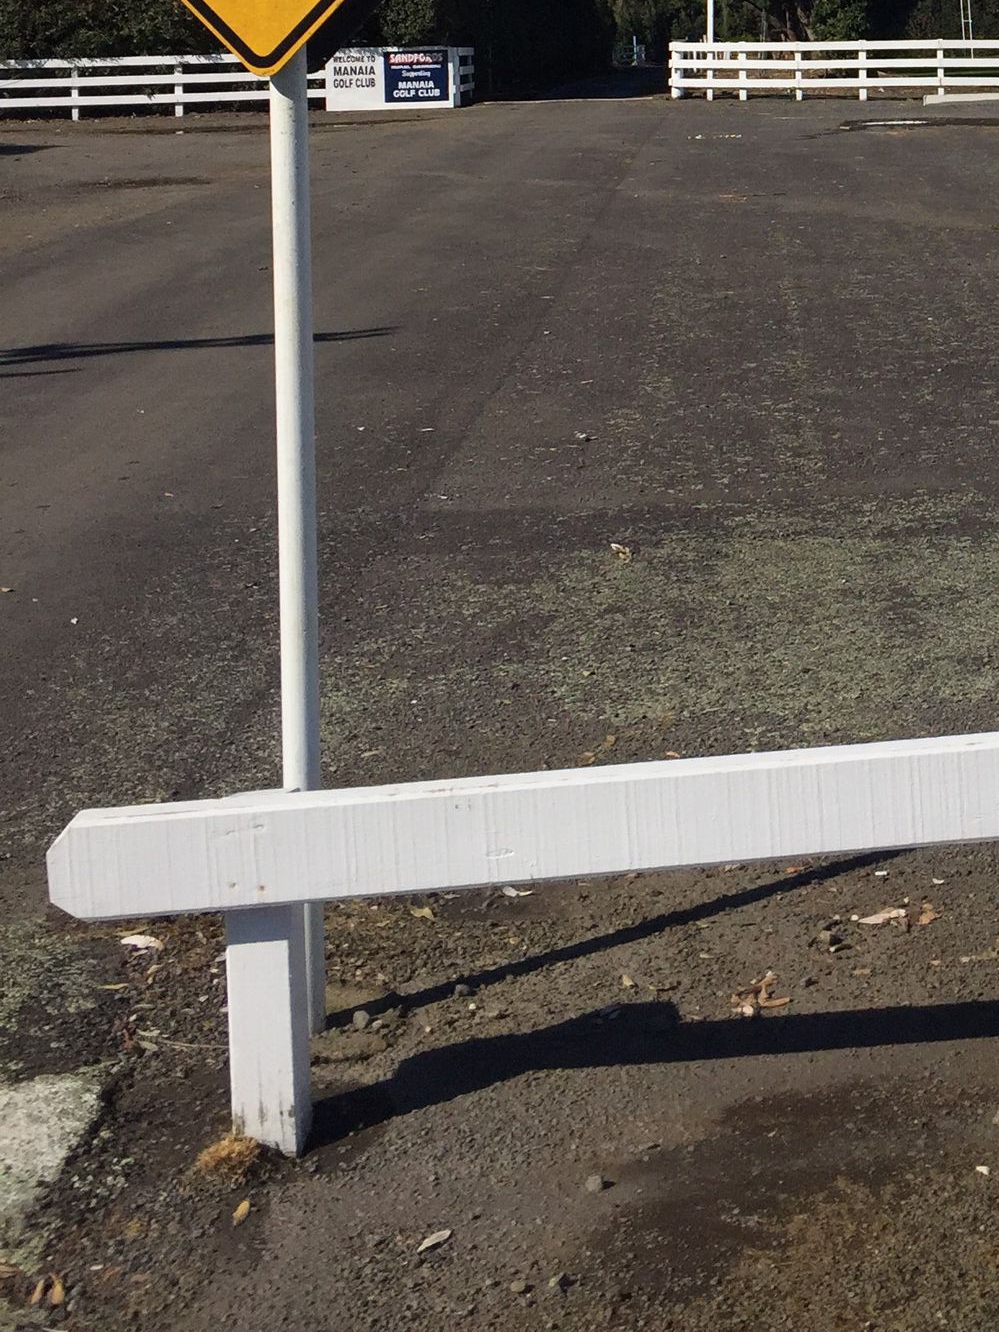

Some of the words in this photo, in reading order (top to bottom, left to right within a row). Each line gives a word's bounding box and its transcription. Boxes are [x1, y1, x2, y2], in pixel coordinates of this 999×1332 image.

[333, 55, 364, 63] WELCOME
[334, 66, 376, 76] MANAIA
[334, 78, 353, 88] GOLF
[356, 78, 376, 88] CLUB
[393, 90, 416, 98] GOLF
[418, 88, 440, 96] CLUB
